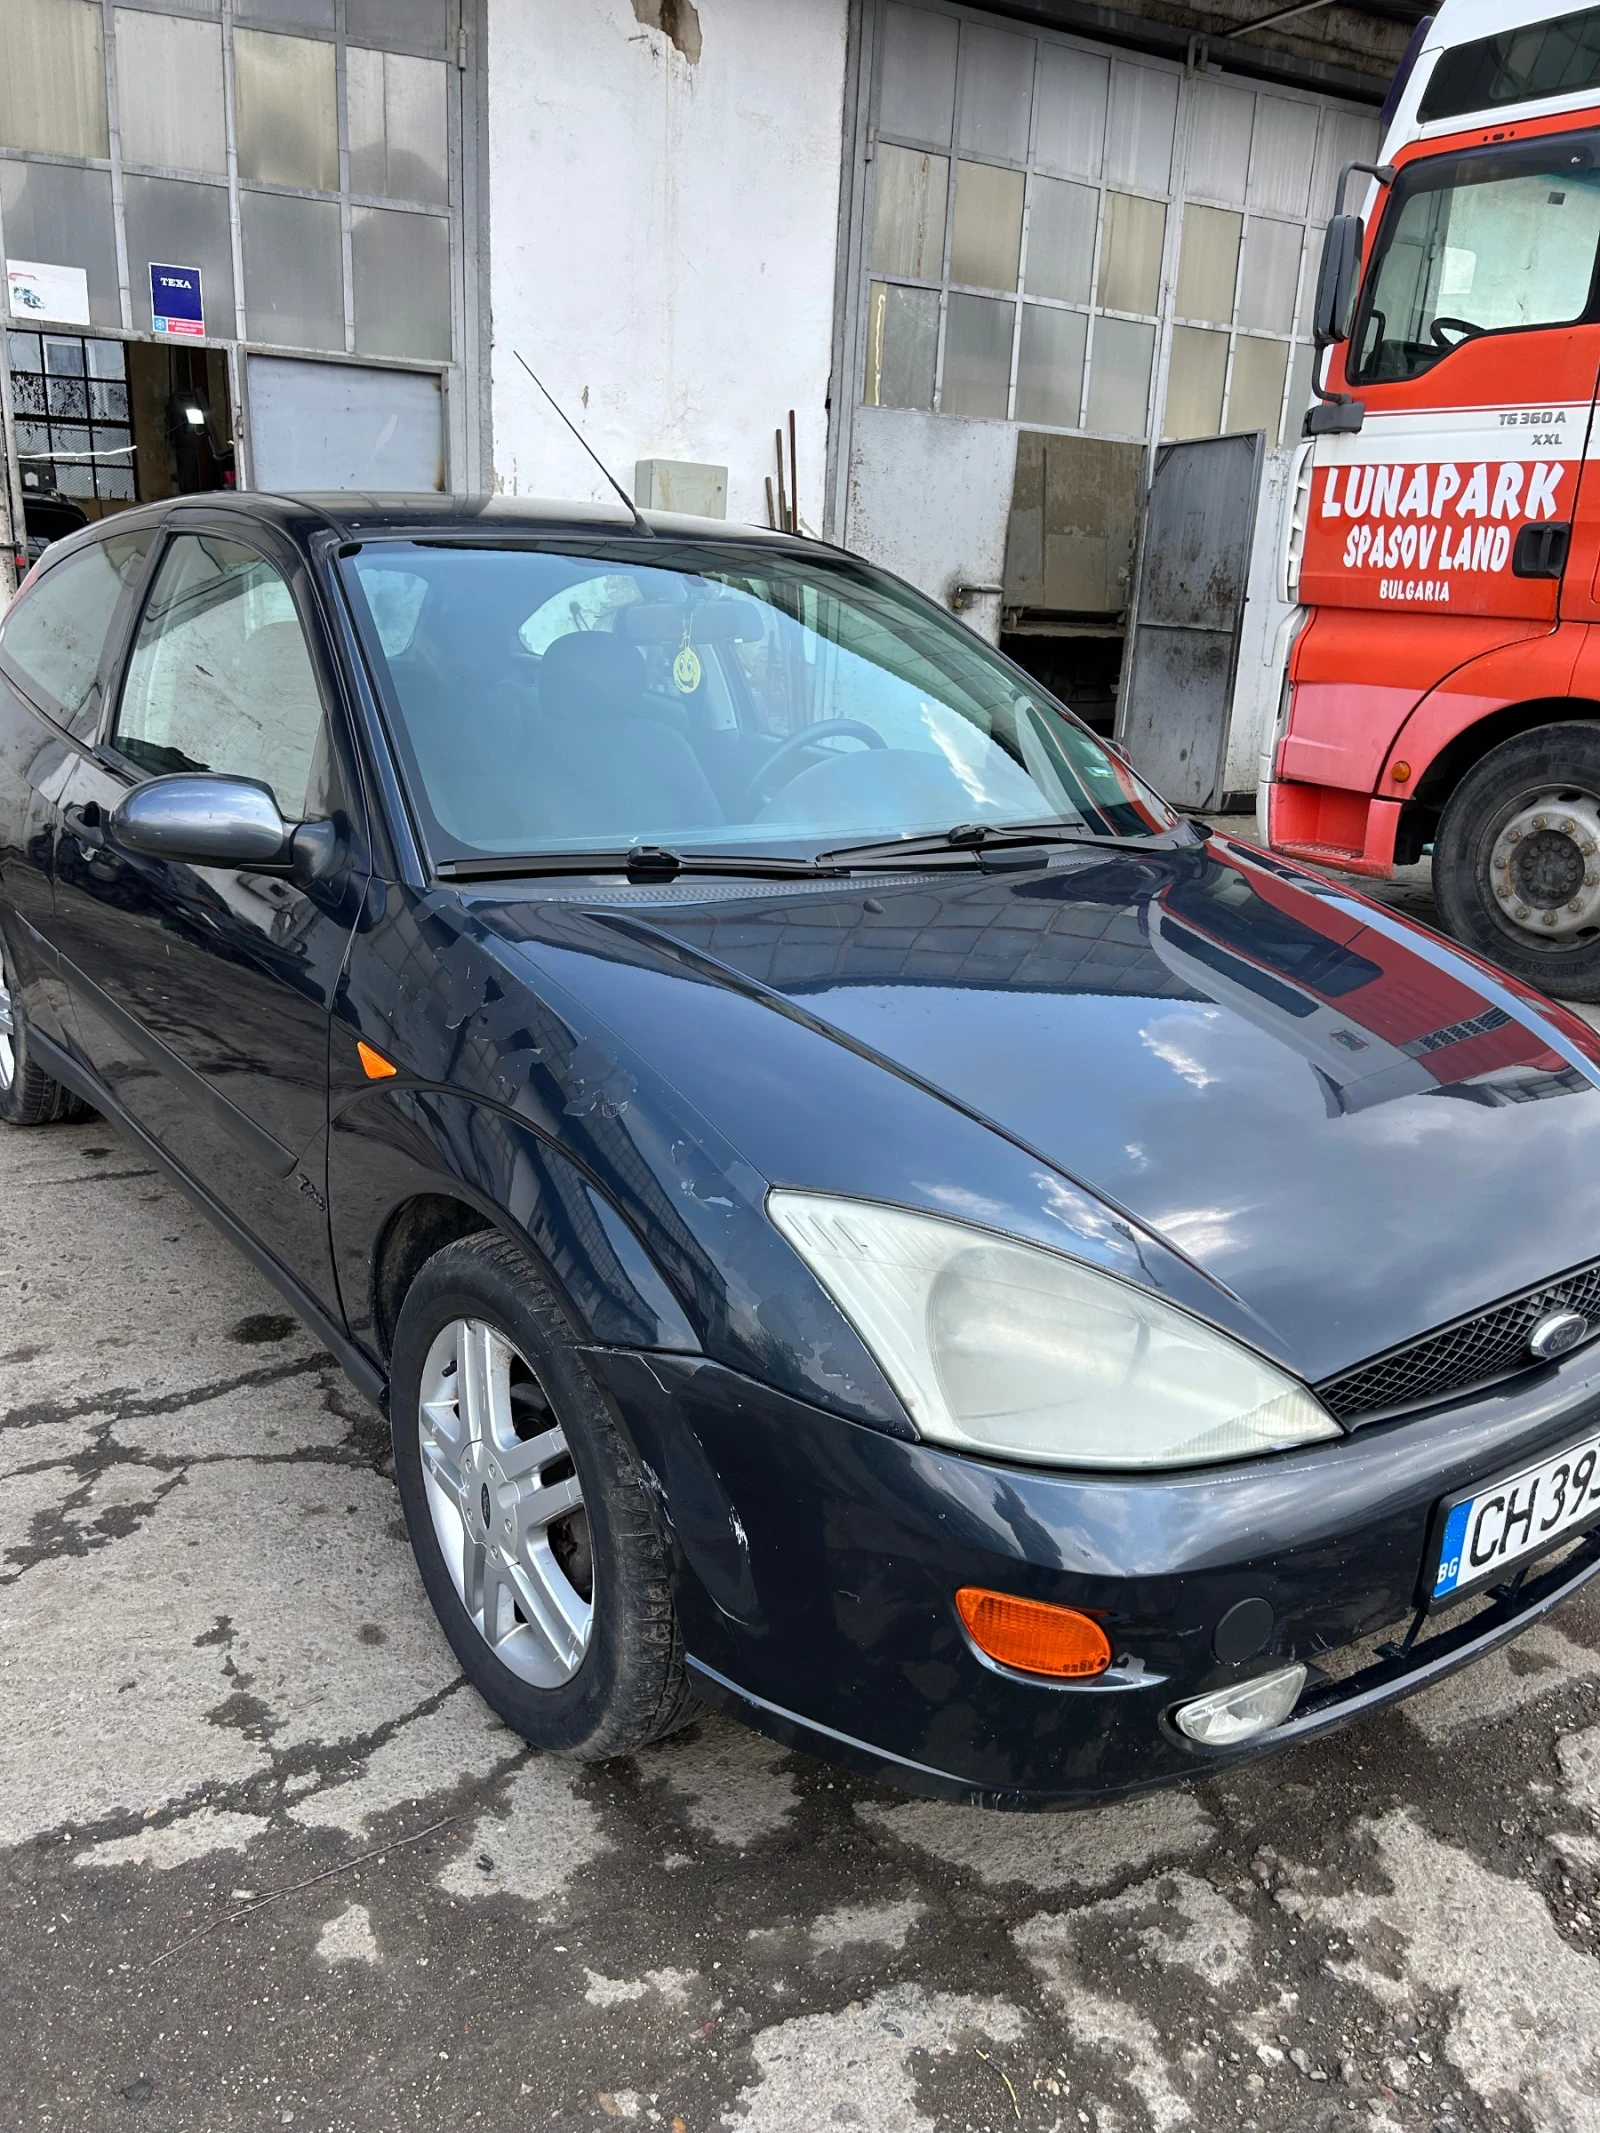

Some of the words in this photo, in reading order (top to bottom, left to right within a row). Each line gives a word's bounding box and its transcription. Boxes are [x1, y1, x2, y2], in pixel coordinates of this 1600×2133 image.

[160, 277, 192, 289] TEXA
[1531, 433, 1562, 445] XXL
[1321, 462, 1565, 521] LUNAPARK
[1342, 524, 1437, 570] SPASOV
[1438, 525, 1511, 573] LAND
[1379, 579, 1450, 602] BULGARIA
[1549, 1324, 1578, 1351] Ford
[1437, 1556, 1459, 1583] BG
